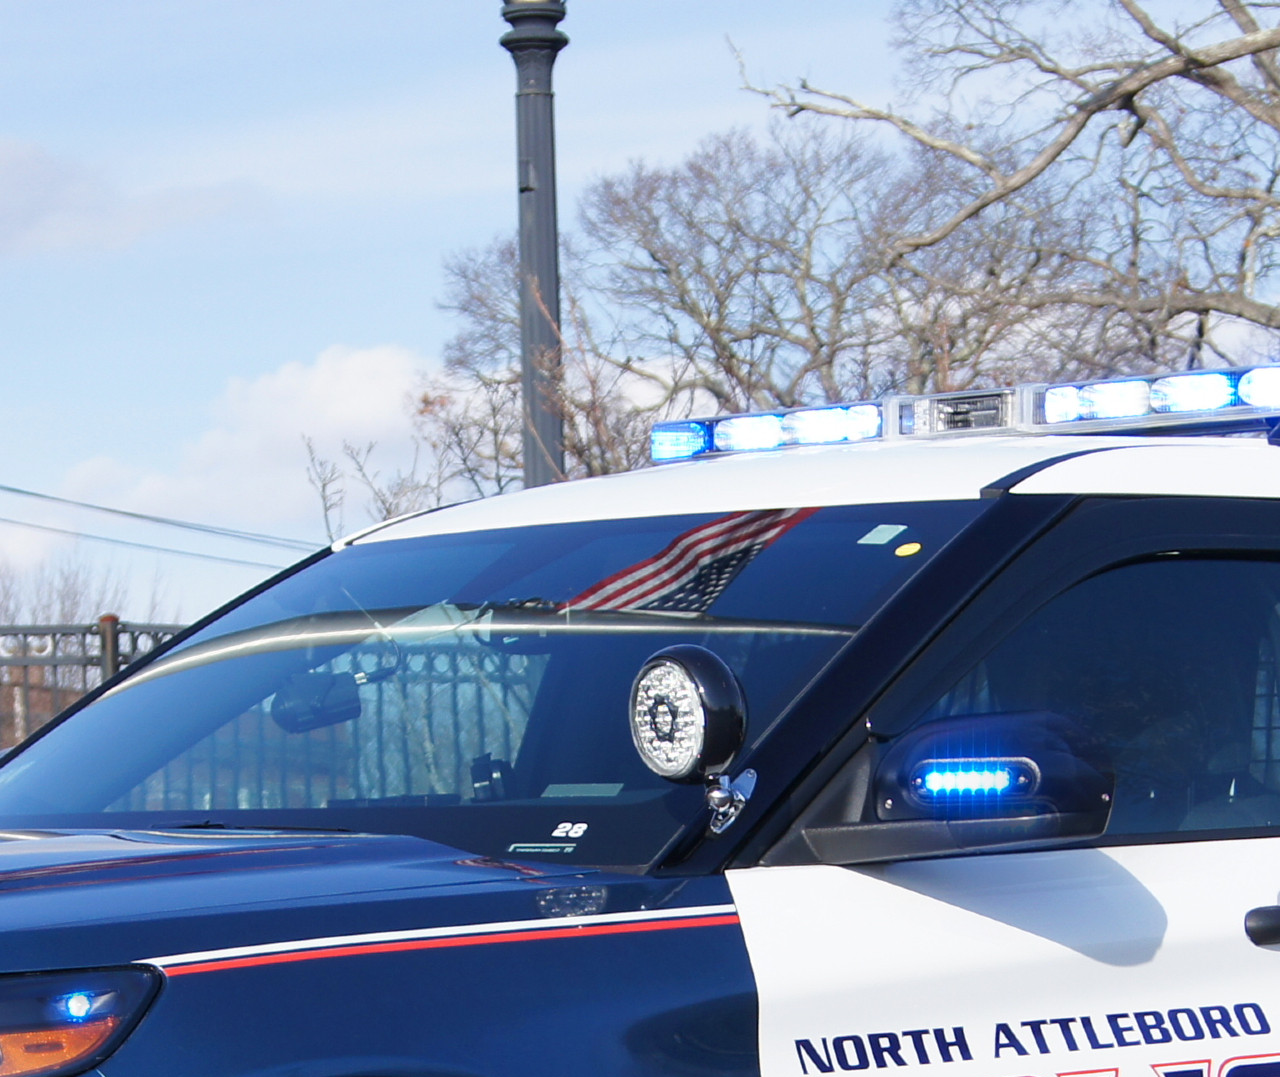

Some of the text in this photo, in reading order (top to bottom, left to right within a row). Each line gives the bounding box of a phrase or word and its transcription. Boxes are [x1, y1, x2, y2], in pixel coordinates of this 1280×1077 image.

[551, 822, 588, 838] 28
[793, 1001, 1272, 1076] NORTH ATTLEBORO
